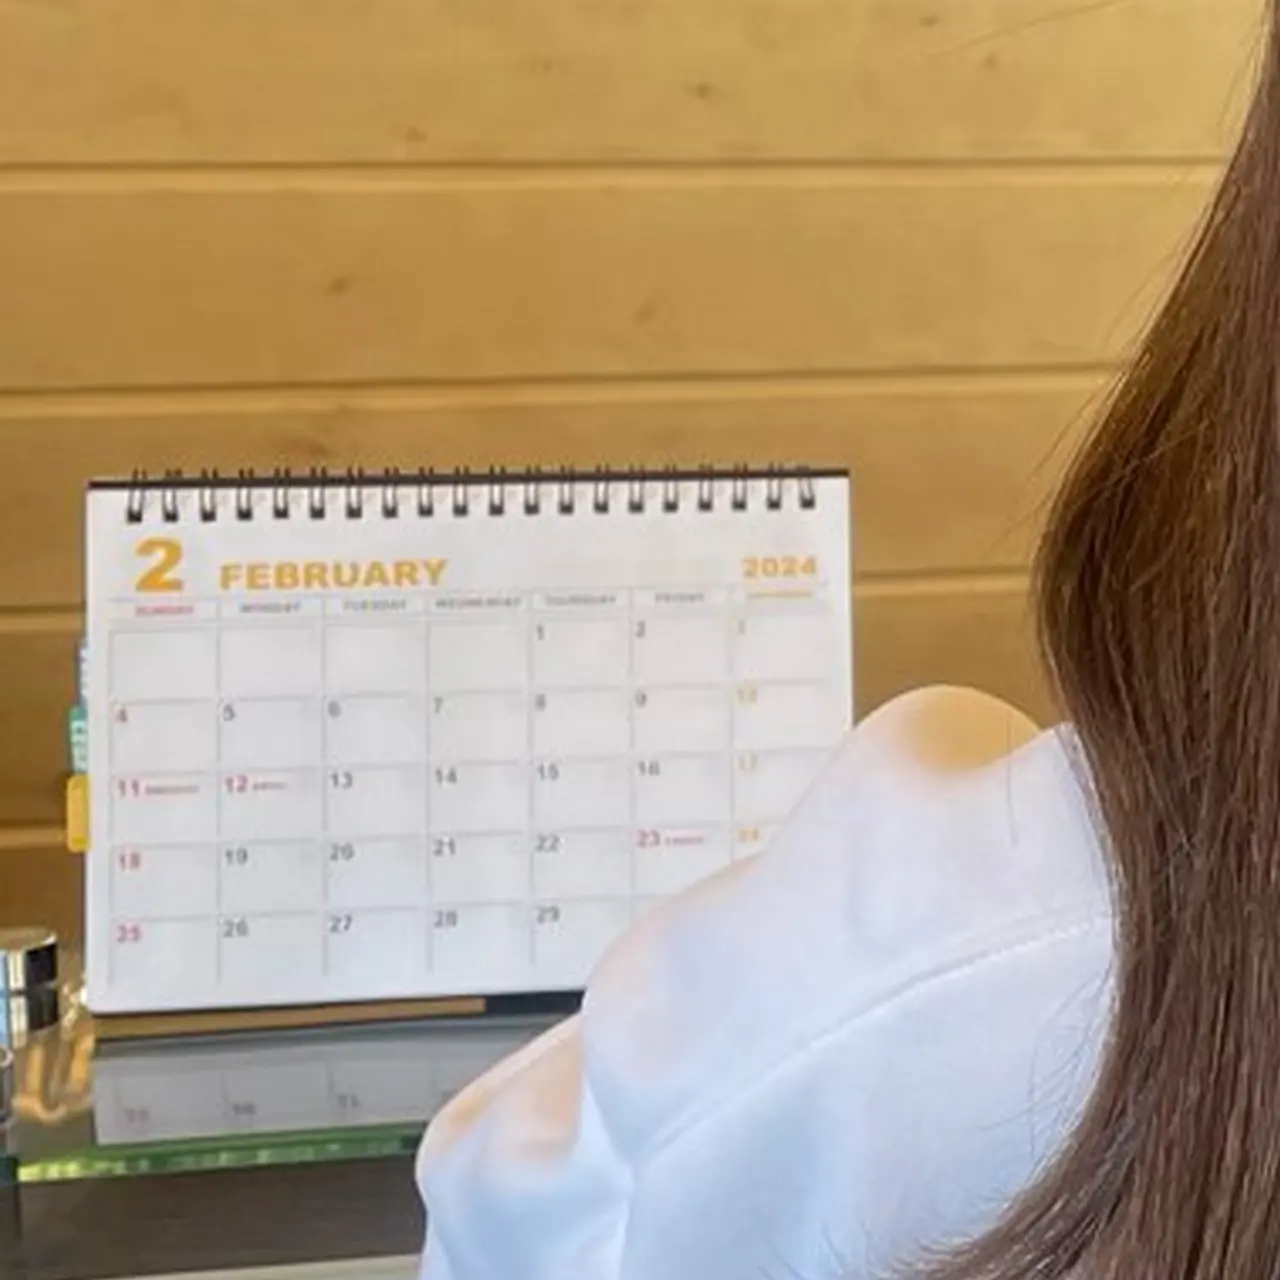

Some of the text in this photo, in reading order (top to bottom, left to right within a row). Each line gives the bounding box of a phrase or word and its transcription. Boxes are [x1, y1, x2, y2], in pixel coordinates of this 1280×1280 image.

[135, 536, 448, 592] 2 FEBRUARY
[743, 555, 818, 579] 2024
[635, 621, 647, 638] 2
[116, 706, 129, 724] 4
[222, 703, 236, 722] 5
[432, 696, 445, 715] 7
[634, 690, 648, 708] 9
[117, 778, 141, 797] 11
[224, 774, 248, 793] 12
[330, 771, 353, 790] 13
[434, 767, 458, 786] 14
[536, 763, 560, 781] 15
[637, 759, 661, 777] 16
[118, 851, 141, 870] 18
[224, 847, 248, 866] 19
[329, 843, 355, 862] 20
[432, 838, 457, 857] 21
[535, 834, 560, 853] 22
[636, 829, 661, 848] 23
[116, 905, 560, 943] 25 26 27 28 29
